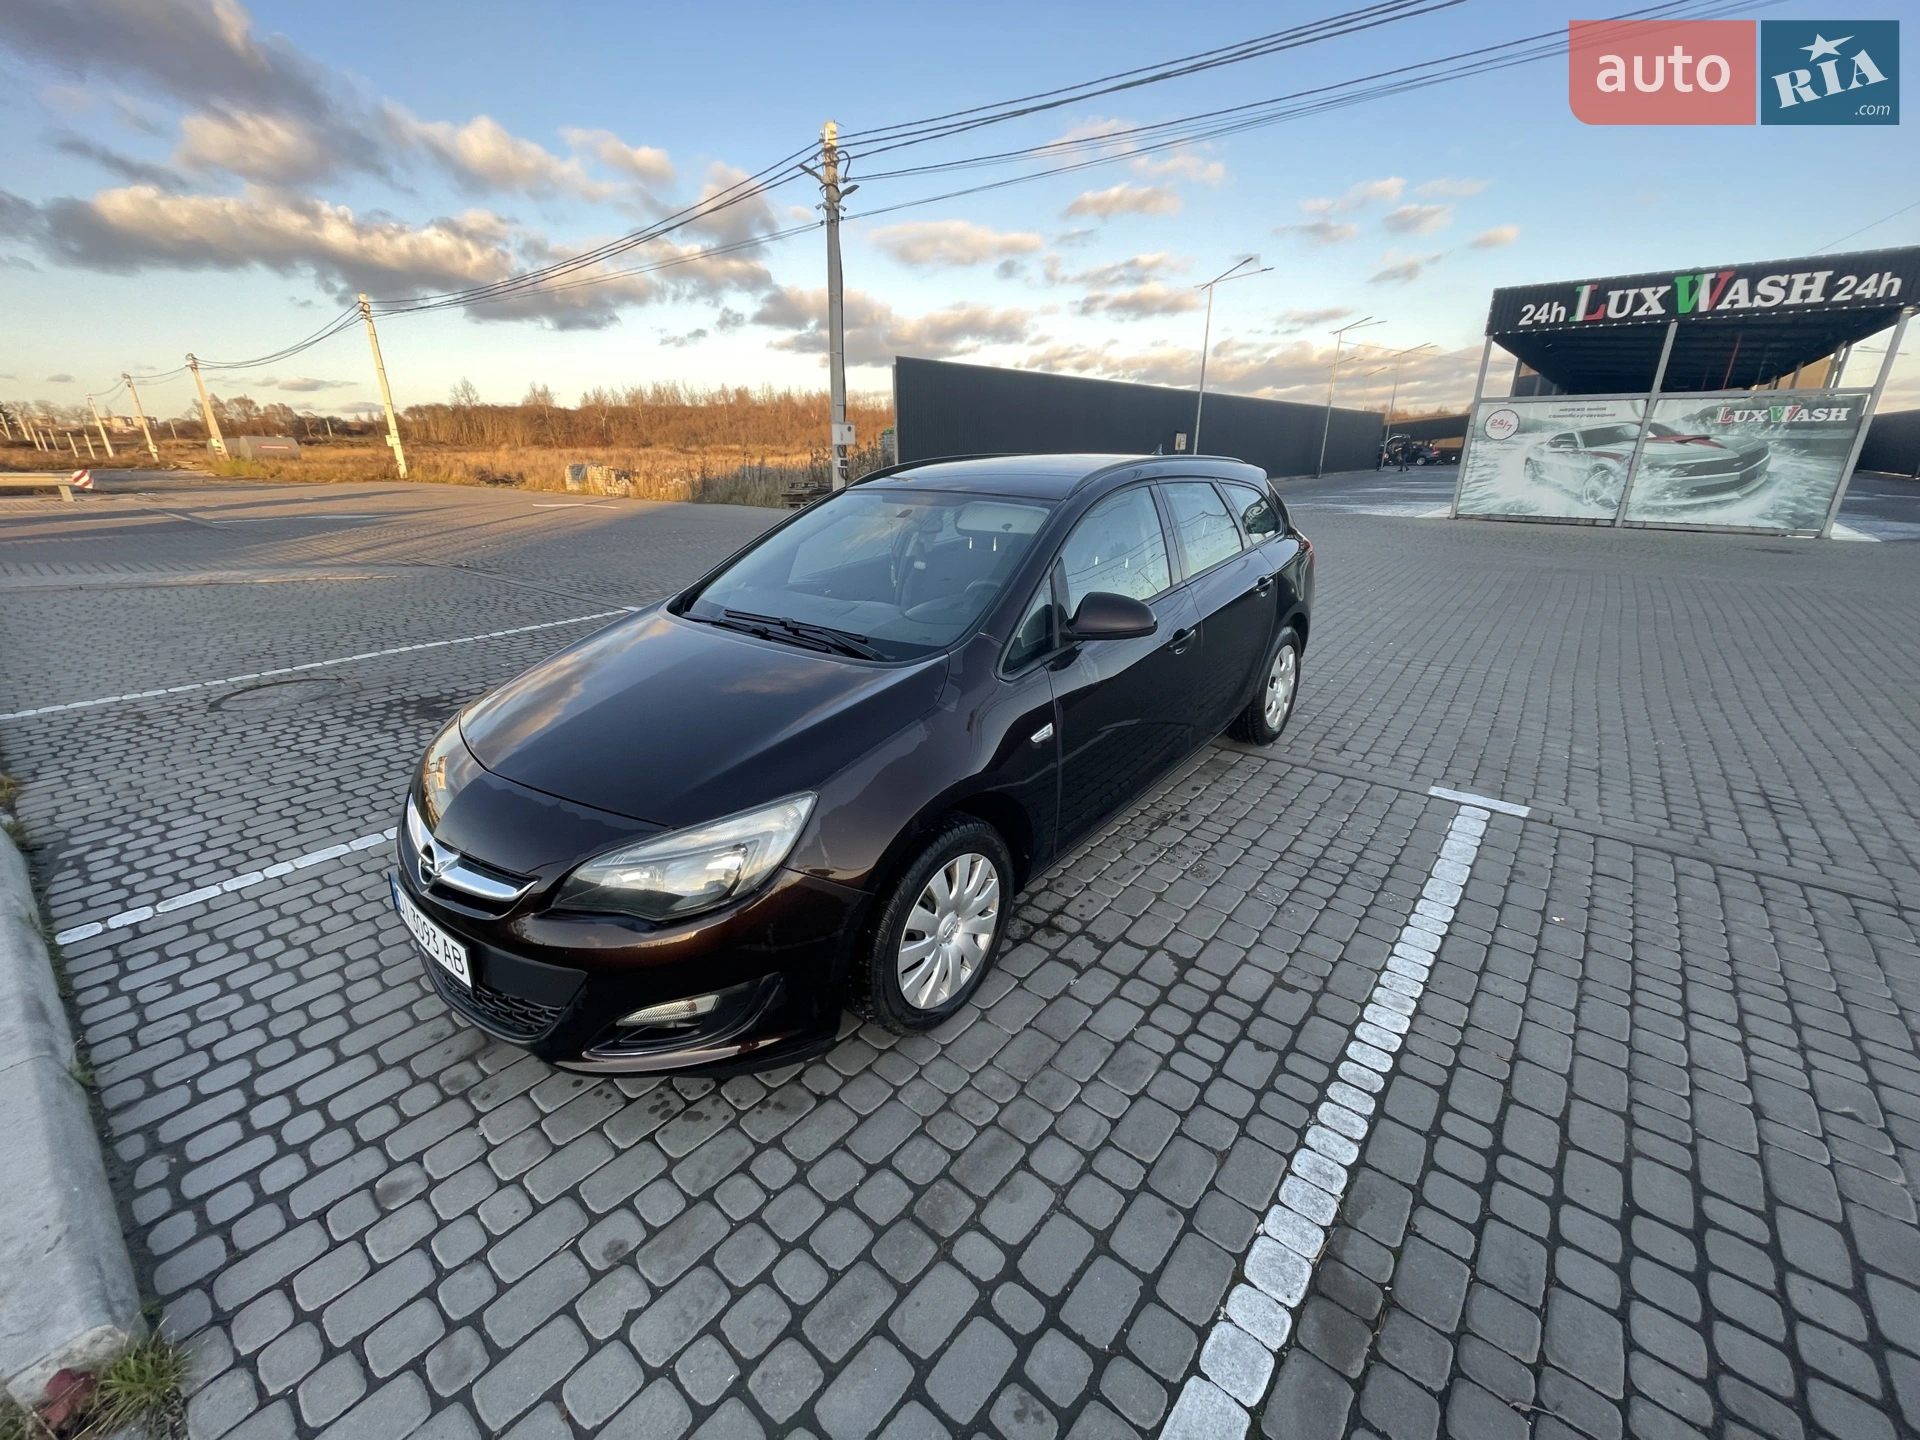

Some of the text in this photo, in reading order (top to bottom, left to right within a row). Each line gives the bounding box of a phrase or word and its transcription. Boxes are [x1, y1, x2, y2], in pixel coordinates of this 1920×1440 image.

[1518, 303, 1566, 325] 24h
[1832, 272, 1902, 301] 24h
[1491, 418, 1512, 431] 24/7
[410, 907, 440, 956] 3093
[442, 938, 465, 975] AB
